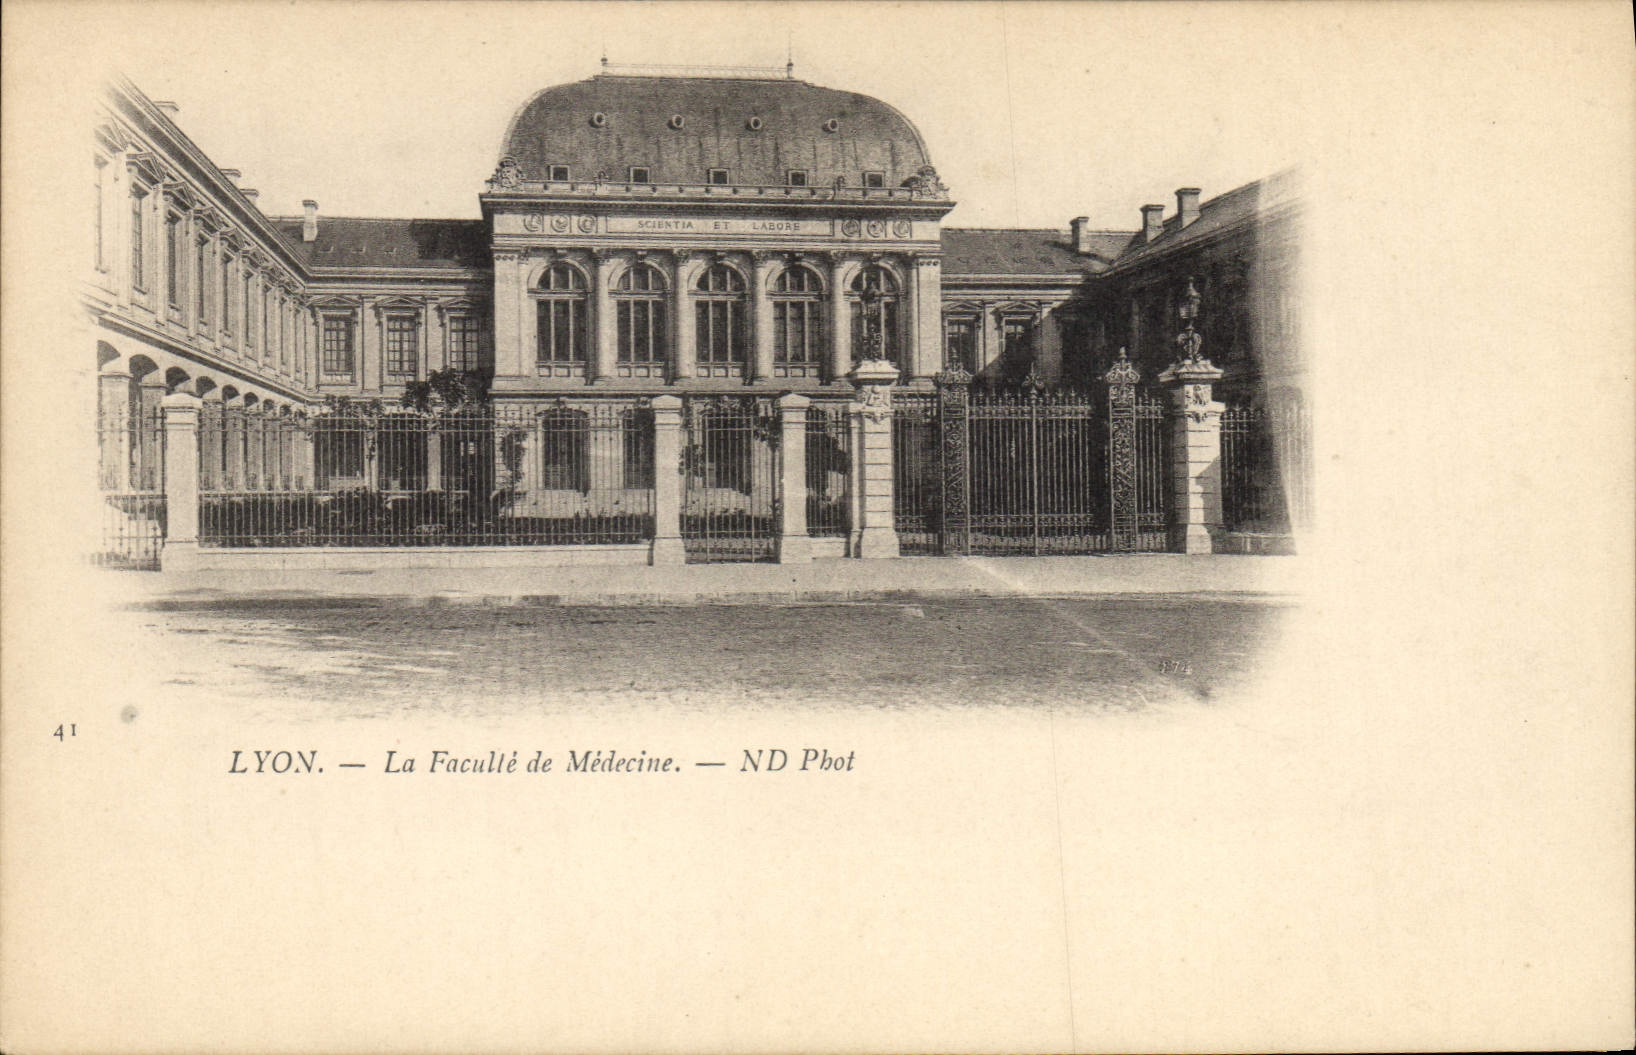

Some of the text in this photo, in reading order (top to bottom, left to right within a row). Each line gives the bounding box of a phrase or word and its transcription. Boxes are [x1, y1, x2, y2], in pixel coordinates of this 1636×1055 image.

[638, 220, 801, 231] SCIENTIA ET LABORE
